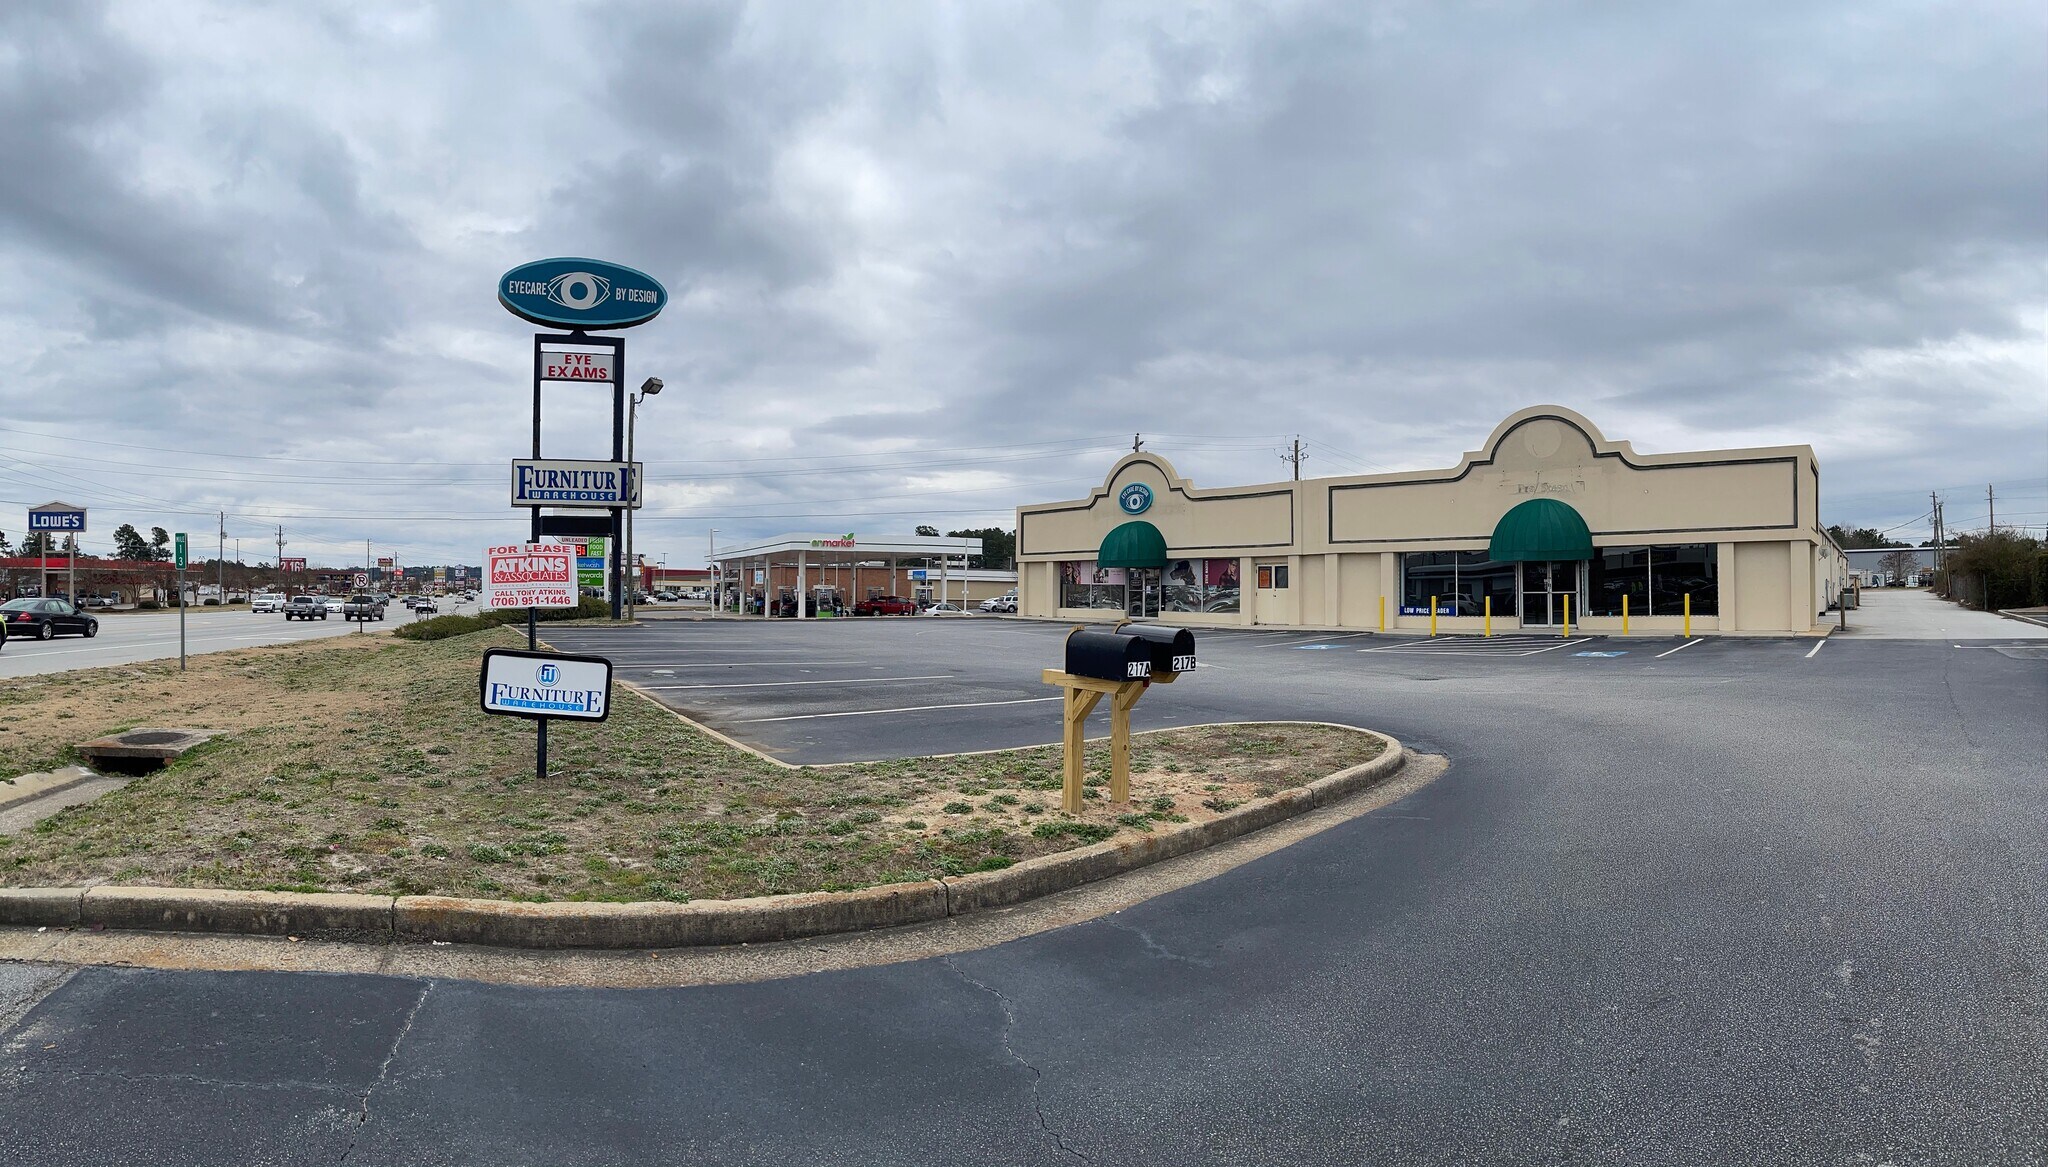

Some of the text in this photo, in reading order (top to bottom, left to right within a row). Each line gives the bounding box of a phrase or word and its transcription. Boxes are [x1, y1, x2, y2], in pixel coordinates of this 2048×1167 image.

[509, 281, 657, 303] EYECARE BY DESIGN
[565, 355, 591, 365] EYE
[548, 366, 607, 379] EXAMS
[516, 465, 638, 502] FURNITURE
[532, 490, 614, 500] WAREHOUSE
[32, 514, 80, 527] LOWE'S
[811, 538, 855, 548] enmarket
[489, 545, 571, 555] FOR LEASE
[493, 557, 566, 573] ATKINS
[491, 596, 571, 607] (706) 951-1446
[1128, 656, 1196, 677] 217A 217B
[489, 682, 602, 713] FURNITURE
[501, 700, 584, 711] WAREHOUSE
